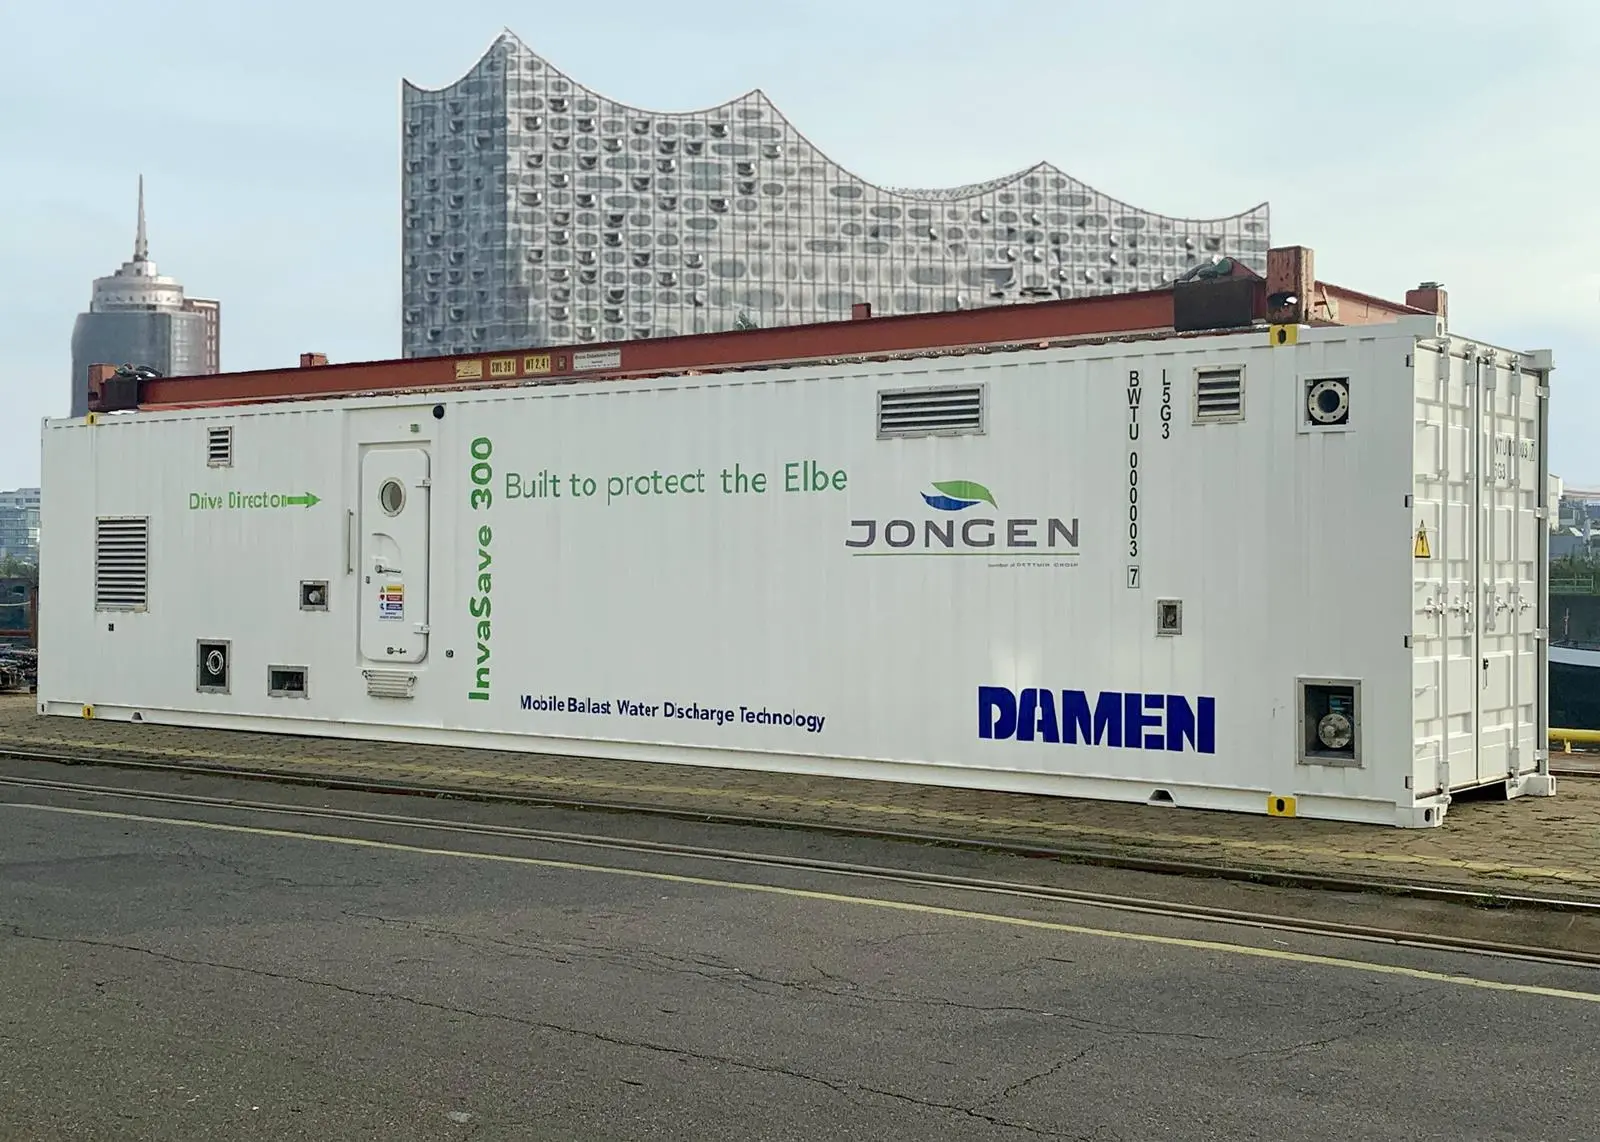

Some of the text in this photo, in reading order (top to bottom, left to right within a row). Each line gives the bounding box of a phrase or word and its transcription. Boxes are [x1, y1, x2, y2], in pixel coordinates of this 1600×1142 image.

[1160, 369, 1172, 439] L5G3
[189, 492, 223, 510] Drive
[505, 460, 848, 506] Built to protect the Elbe
[1127, 371, 1142, 585] BWTU 000003 7
[845, 518, 1079, 548] JONGEN
[468, 436, 493, 701] InvaSave 300
[520, 695, 565, 712] Mobile
[616, 699, 660, 718] Water
[739, 706, 826, 733] Technology
[978, 686, 1216, 755] DAMEN
